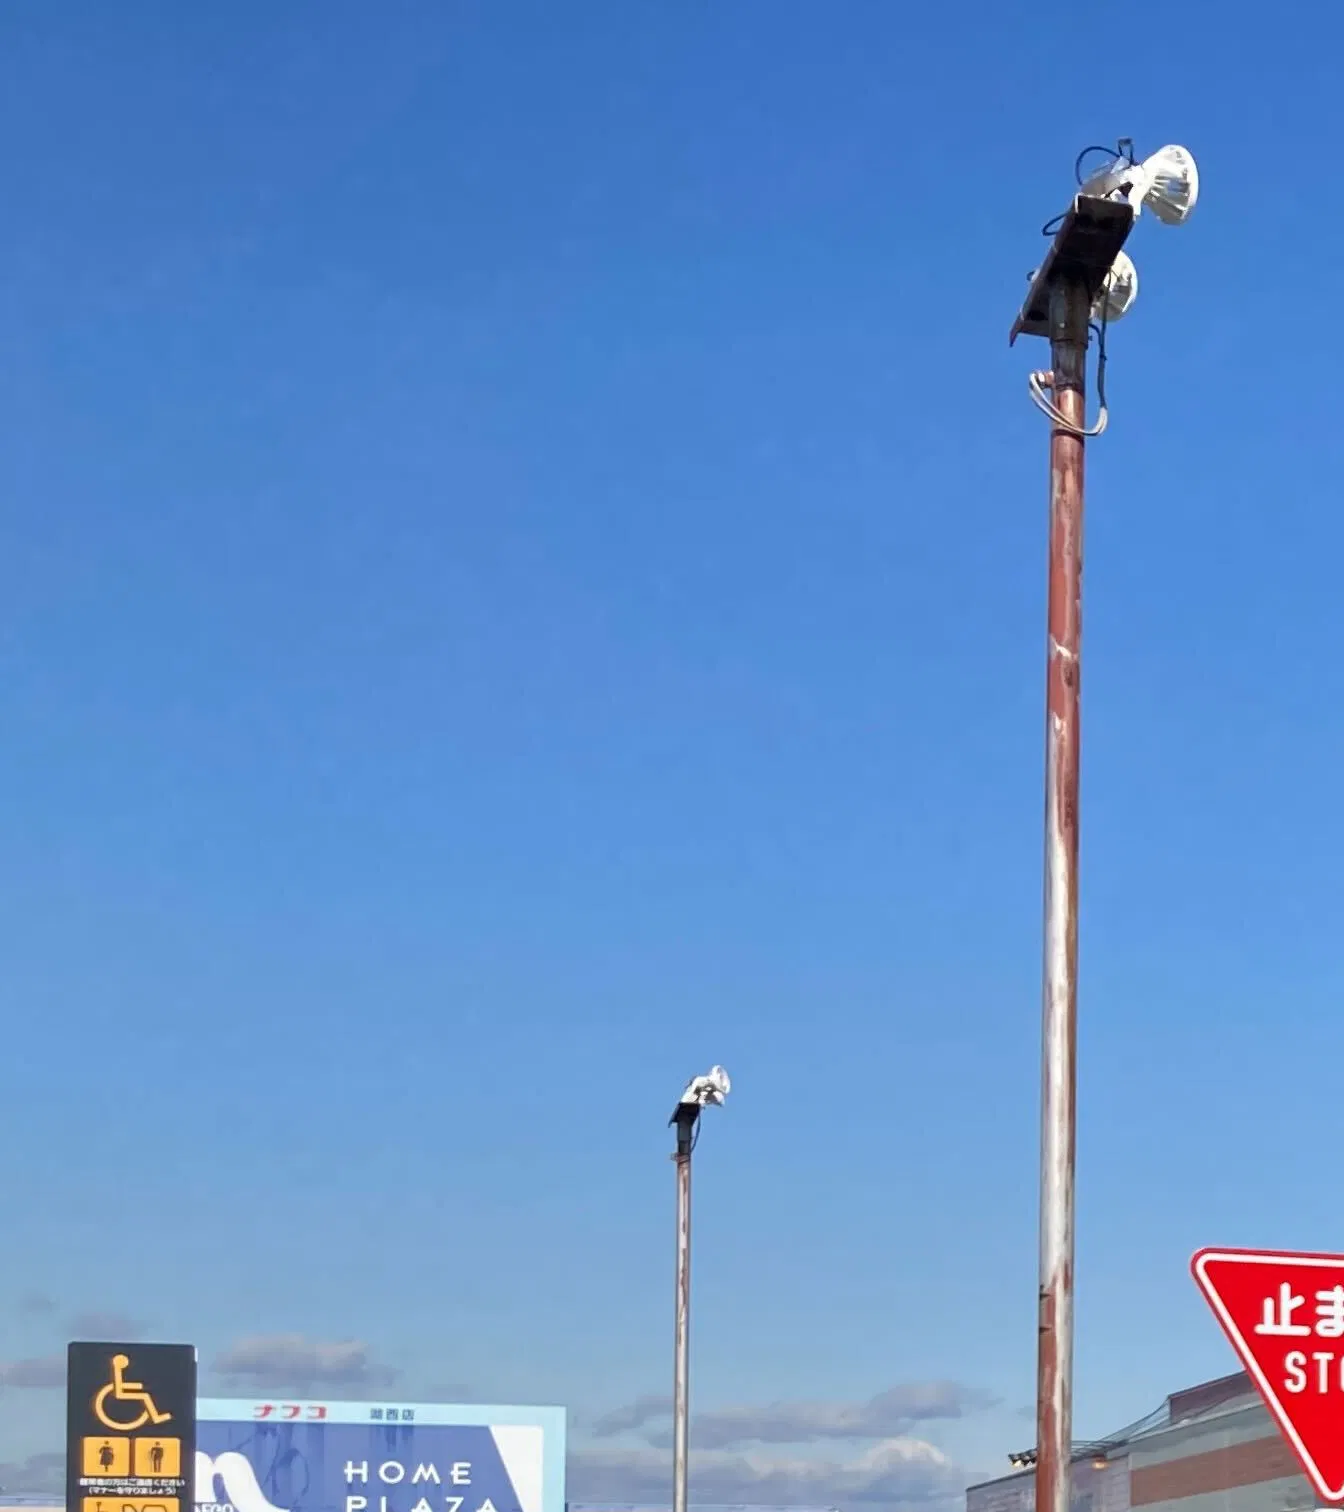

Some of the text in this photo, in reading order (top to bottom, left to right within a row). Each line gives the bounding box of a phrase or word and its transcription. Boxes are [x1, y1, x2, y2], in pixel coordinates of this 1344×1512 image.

[253, 1404, 327, 1420] ナフコ
[344, 1461, 472, 1485] HOME
